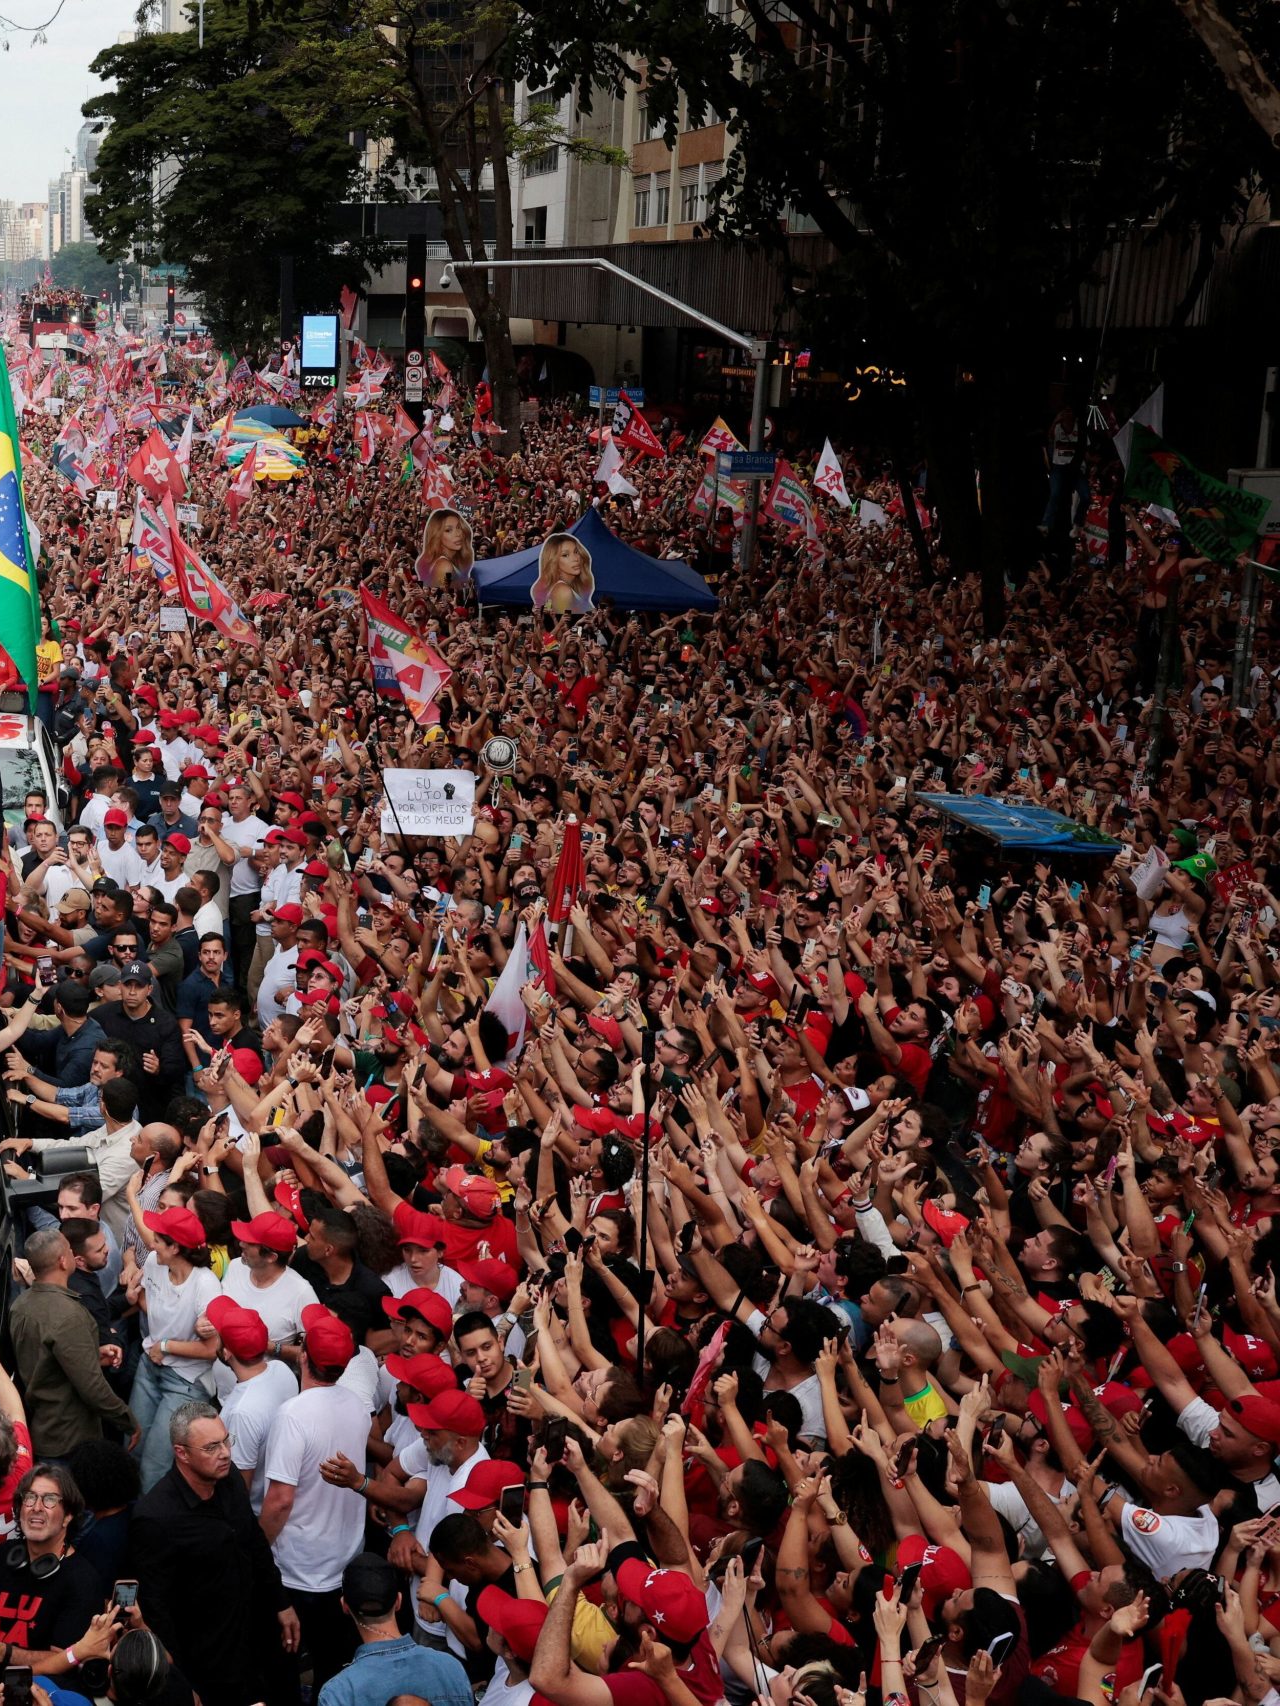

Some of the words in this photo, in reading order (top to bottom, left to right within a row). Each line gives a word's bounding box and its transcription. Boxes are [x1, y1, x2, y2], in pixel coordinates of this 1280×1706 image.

[409, 354, 420, 362] 50
[304, 375, 330, 386] 27°C
[746, 453, 774, 465] Branca
[150, 462, 164, 481] PT
[825, 467, 841, 490] 13
[416, 777, 431, 789] EU
[407, 790, 442, 802] LUTO
[398, 803, 417, 813] POR
[414, 814, 431, 824] DOS
[436, 814, 464, 825] MEUS!
[130, 963, 140, 974] NY
